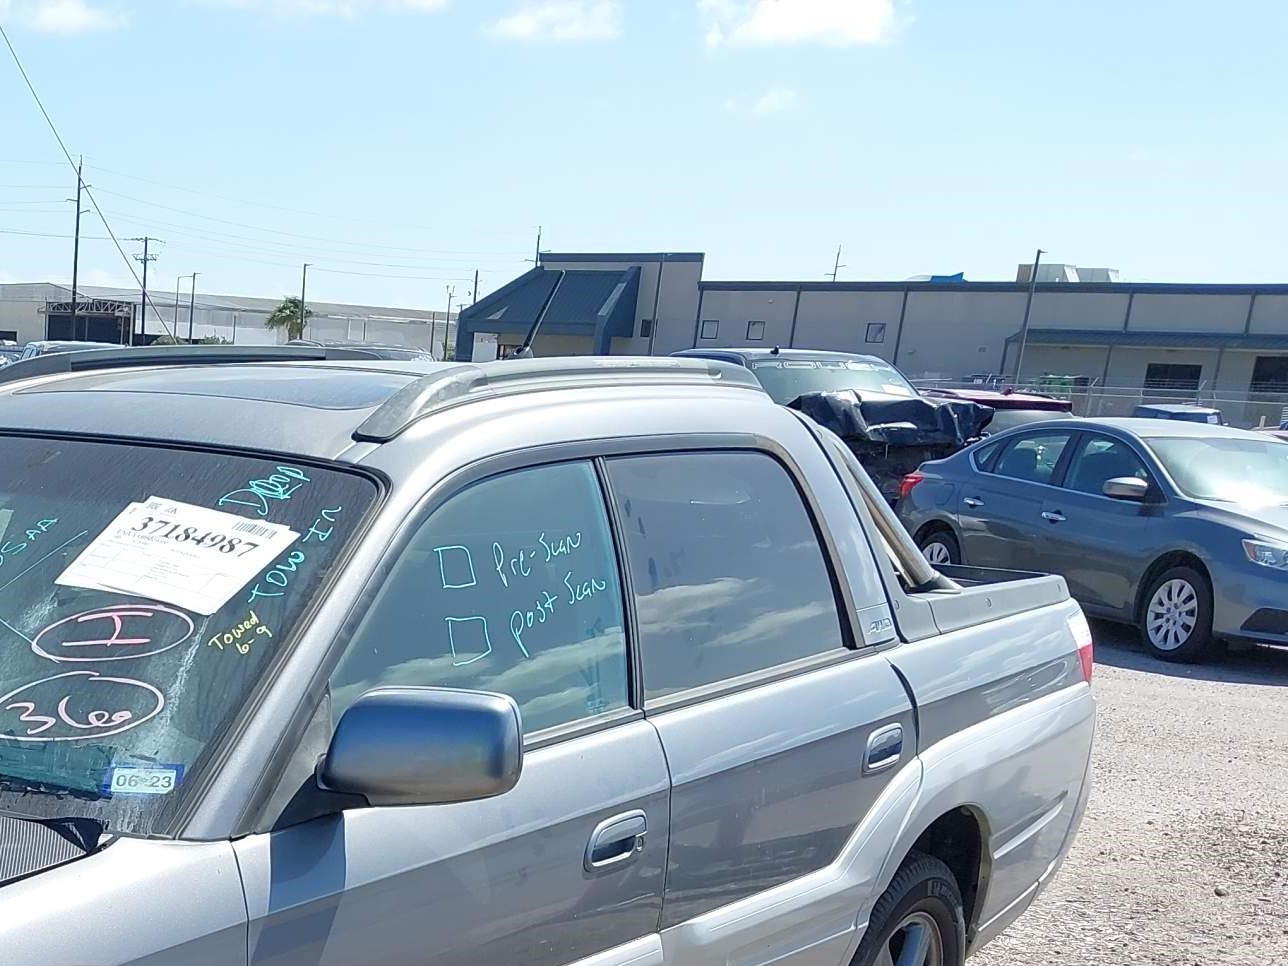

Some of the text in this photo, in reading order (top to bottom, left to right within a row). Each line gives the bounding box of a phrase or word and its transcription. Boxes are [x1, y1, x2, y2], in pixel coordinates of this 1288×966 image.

[131, 516, 260, 557] 37184987
[208, 610, 259, 650] Towed
[116, 774, 172, 789] 06 23
